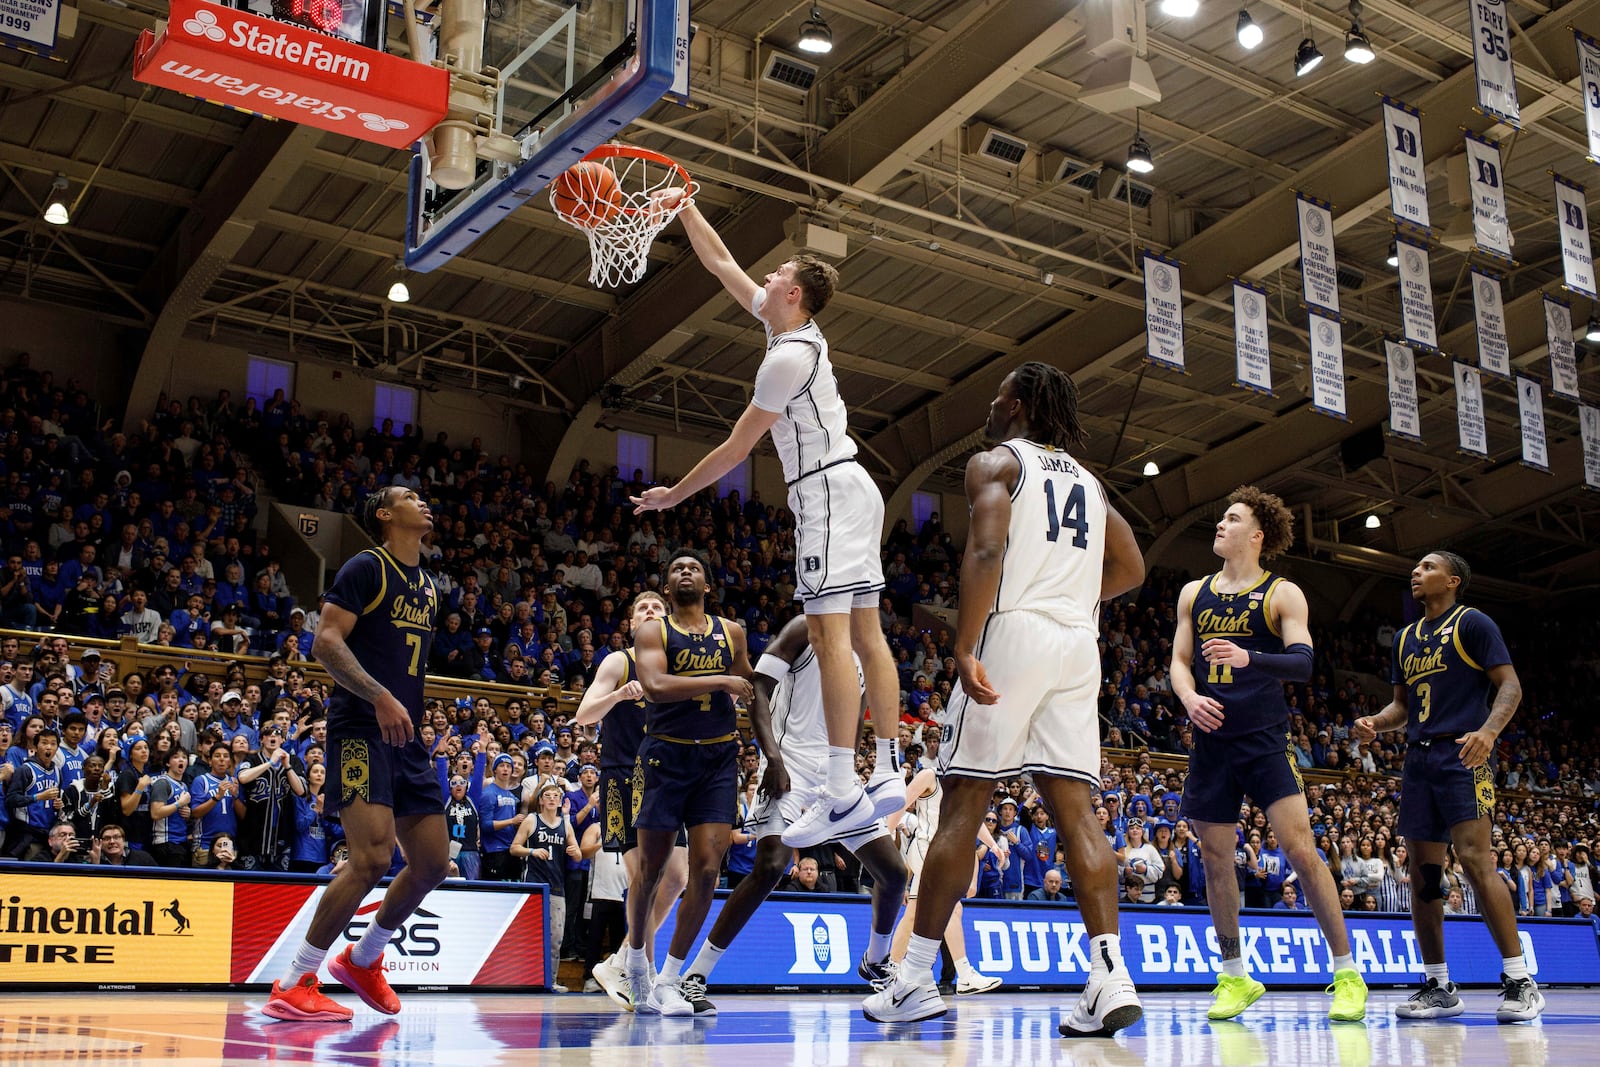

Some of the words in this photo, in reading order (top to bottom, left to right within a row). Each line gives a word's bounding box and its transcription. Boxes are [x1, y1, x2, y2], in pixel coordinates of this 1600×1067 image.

[0, 5, 39, 20] URNAMENT
[20, 3, 46, 15] SEASON
[0, 14, 30, 31] 1999
[1477, 3, 1504, 31] FERRY
[1480, 27, 1508, 61] 35
[1400, 165, 1416, 177] NCAA
[1392, 176, 1410, 190] FINAL
[1411, 183, 1426, 196] FOUR
[1483, 195, 1498, 208] NCAA
[1307, 240, 1329, 256] ATLANTIC
[1570, 238, 1585, 250] NCAA
[1311, 251, 1327, 263] COAST
[1564, 248, 1578, 260] FINAL
[1304, 257, 1336, 276] CONFERENCE
[1306, 268, 1336, 286] CHAMPIONS
[1406, 280, 1427, 294] ATLANTIC
[1410, 290, 1425, 301] COAST
[1152, 297, 1177, 311] ATLANTIC
[1403, 296, 1433, 313] CONFERENCE
[1157, 307, 1173, 319] COAST
[1405, 306, 1433, 322] CHAMPIONS
[1148, 314, 1181, 331] CONFERENCE
[1150, 324, 1180, 339] CHAMPIONS
[1241, 325, 1264, 338] ATLANTIC
[1478, 326, 1508, 341] CONFERENCE
[1245, 334, 1260, 345] COAST
[1480, 336, 1507, 350] CHAMPIONS
[1238, 341, 1268, 357] CONFERENCE
[1240, 350, 1268, 365] CHAMPIONS
[1317, 351, 1338, 363] ATLANTIC
[1321, 360, 1336, 371] COAST
[1314, 366, 1343, 382] CONFERENCE
[1315, 376, 1343, 390] CHAMPIONS
[1038, 455, 1079, 478] JAMES
[1043, 478, 1089, 550] 14
[303, 520, 317, 533] 15
[390, 595, 431, 628] Irish
[1197, 608, 1252, 635] Irish
[405, 632, 421, 677] 7
[673, 647, 726, 673] Irish
[1404, 646, 1448, 681] Irish
[1416, 682, 1431, 723] 3
[222, 798, 227, 814] 1
[538, 831, 564, 845] Duke
[548, 845, 553, 861] 1
[0, 944, 115, 963] TIRE
[384, 962, 440, 971] IBUTION
